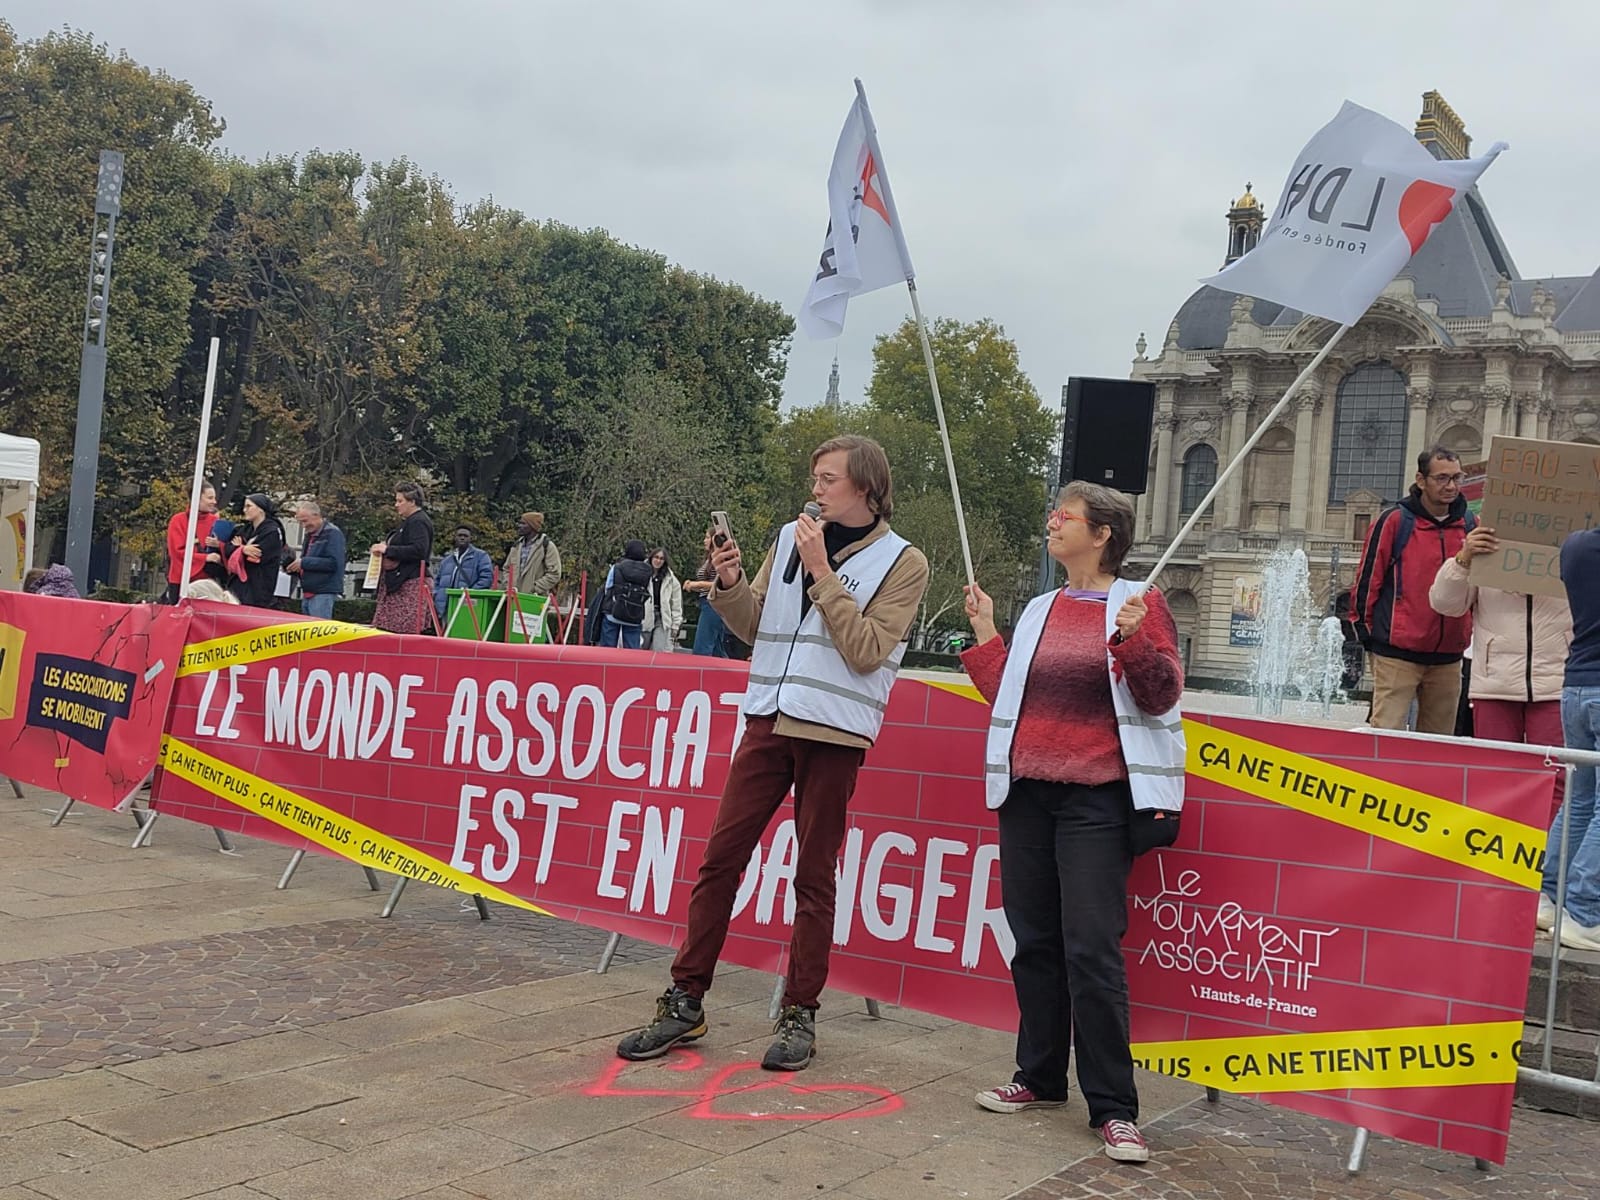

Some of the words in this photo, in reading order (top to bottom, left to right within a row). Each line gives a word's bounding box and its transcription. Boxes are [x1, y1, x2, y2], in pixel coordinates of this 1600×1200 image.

[1502, 448, 1560, 479] EAU
[839, 573, 860, 591] DH
[188, 649, 213, 666] TIENT
[214, 643, 239, 661] PLUS
[250, 639, 262, 656] ÇA
[264, 635, 278, 649] NE
[279, 627, 310, 646] TIENT
[310, 625, 339, 639] PLUS
[43, 666, 61, 687] LES
[61, 670, 128, 703] ASSOCIATIONS
[41, 697, 55, 717] SE
[55, 699, 107, 730] MOBILISENT
[195, 664, 247, 739] LE
[264, 667, 424, 760] MONDE
[171, 750, 182, 765] ÇA
[183, 756, 197, 772] NE
[197, 762, 224, 785] TIENT
[224, 775, 250, 797] PLUS
[260, 792, 274, 809] ÇA
[276, 800, 293, 817] NE
[294, 806, 324, 832] TIENT
[323, 821, 351, 845] PLUS
[360, 840, 375, 857] ÇA
[377, 848, 391, 864] NE
[393, 854, 429, 881] TIENT
[1199, 742, 1232, 770] ÇA
[1236, 752, 1272, 784] NE
[1279, 765, 1356, 809] TIENT
[1358, 792, 1432, 834] PLUS
[1463, 827, 1505, 860] ÇA
[450, 783, 579, 885] EST
[597, 800, 684, 916] EN
[1157, 853, 1202, 897] Le
[1139, 938, 1313, 991] ASSOCIATIF
[1223, 1054, 1261, 1082] ÇA
[1268, 1051, 1303, 1075] NE
[1309, 1047, 1392, 1073] TIENT
[1399, 1042, 1475, 1071] PLUS
